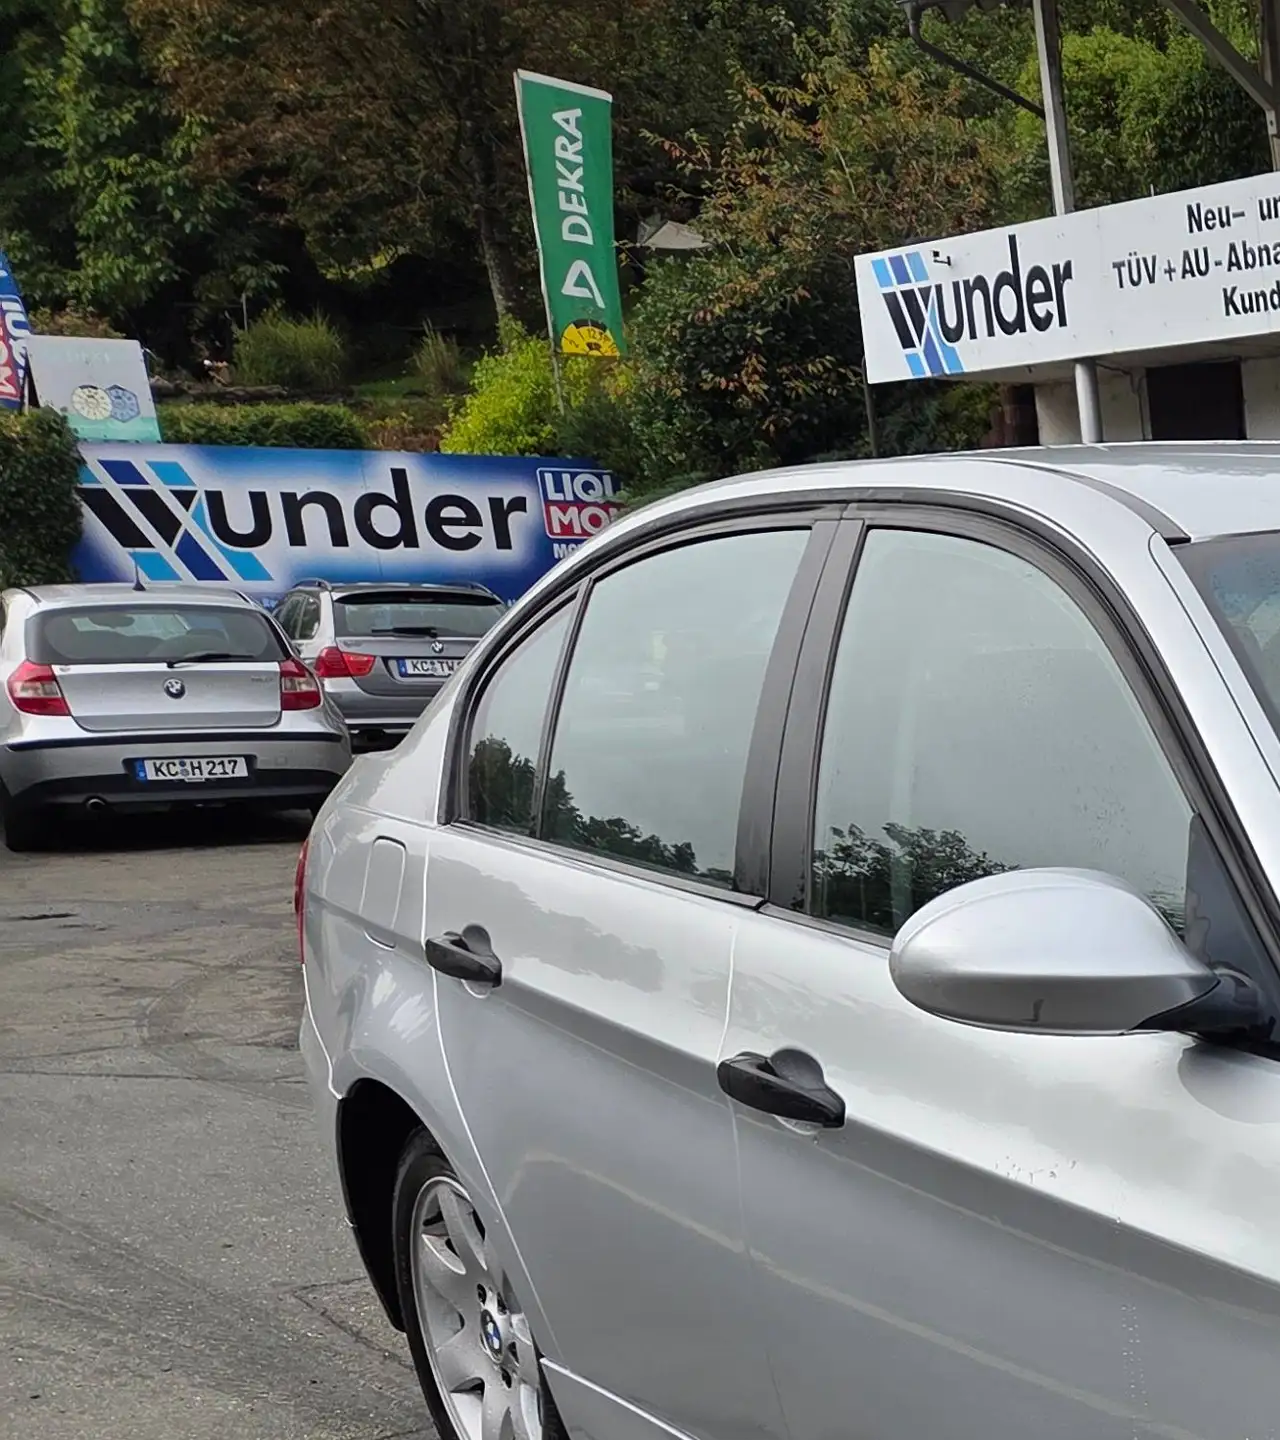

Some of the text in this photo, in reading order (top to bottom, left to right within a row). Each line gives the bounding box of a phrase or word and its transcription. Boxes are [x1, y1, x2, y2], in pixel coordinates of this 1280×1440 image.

[552, 108, 594, 246] DEKRA
[882, 234, 1073, 351] Wunder
[77, 467, 527, 552] Wunder
[544, 472, 614, 502] LIQ
[550, 506, 618, 534] MO
